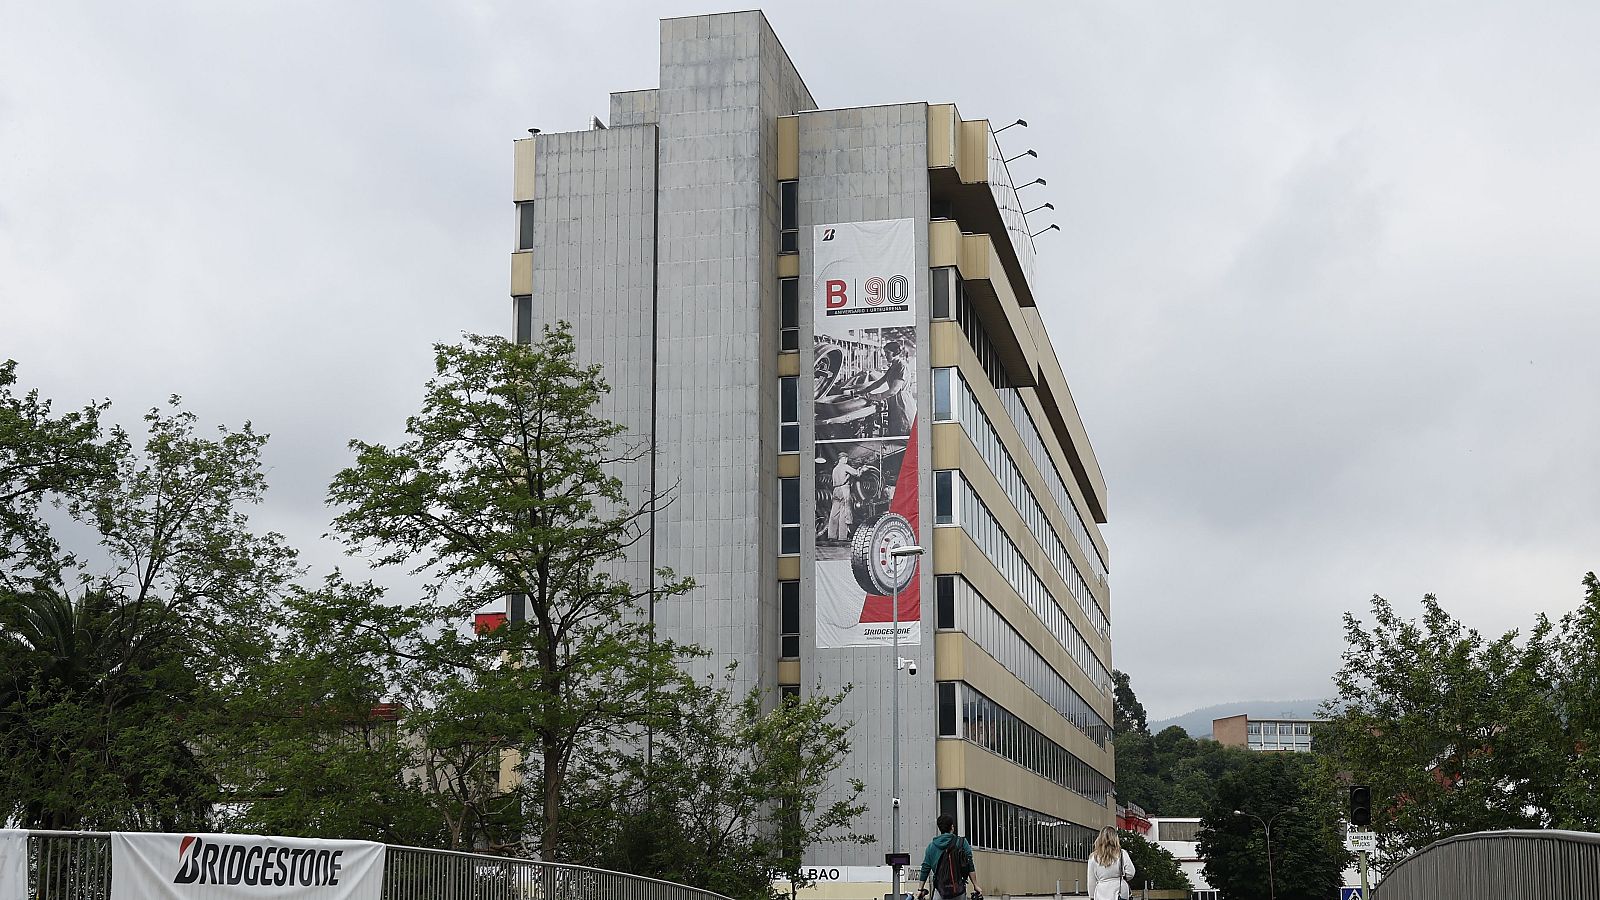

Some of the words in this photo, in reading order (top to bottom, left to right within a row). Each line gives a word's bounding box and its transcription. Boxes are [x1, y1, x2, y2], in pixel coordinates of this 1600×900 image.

[826, 280, 848, 309] B
[864, 275, 909, 306] 90
[173, 835, 344, 887] BRIDGESTONE
